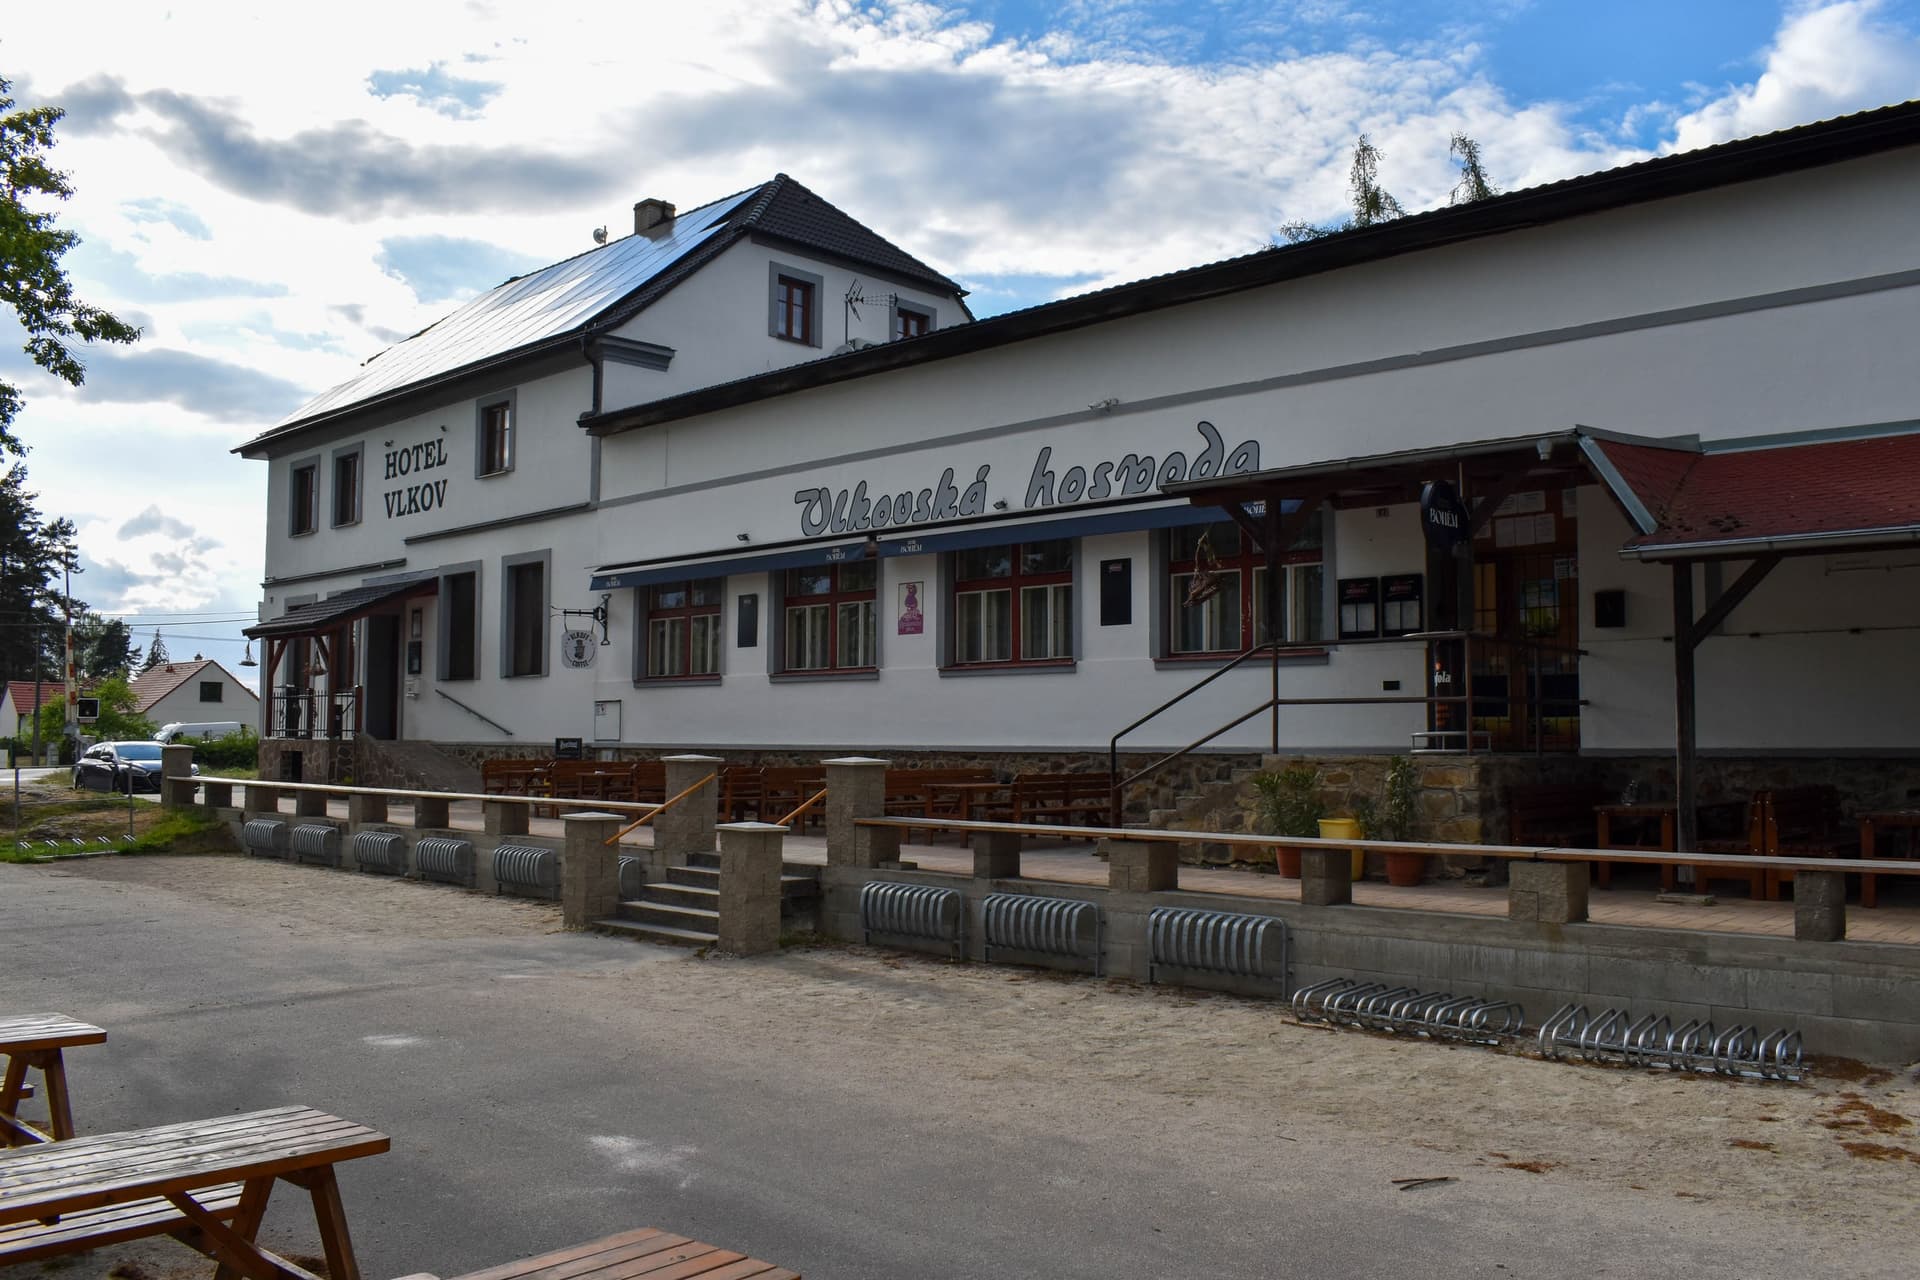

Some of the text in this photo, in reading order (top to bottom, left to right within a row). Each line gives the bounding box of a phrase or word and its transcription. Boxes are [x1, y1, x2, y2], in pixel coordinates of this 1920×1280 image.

[385, 438, 448, 480] HOTEL
[1024, 421, 1260, 509] hospoda
[384, 479, 448, 519] VLKOV
